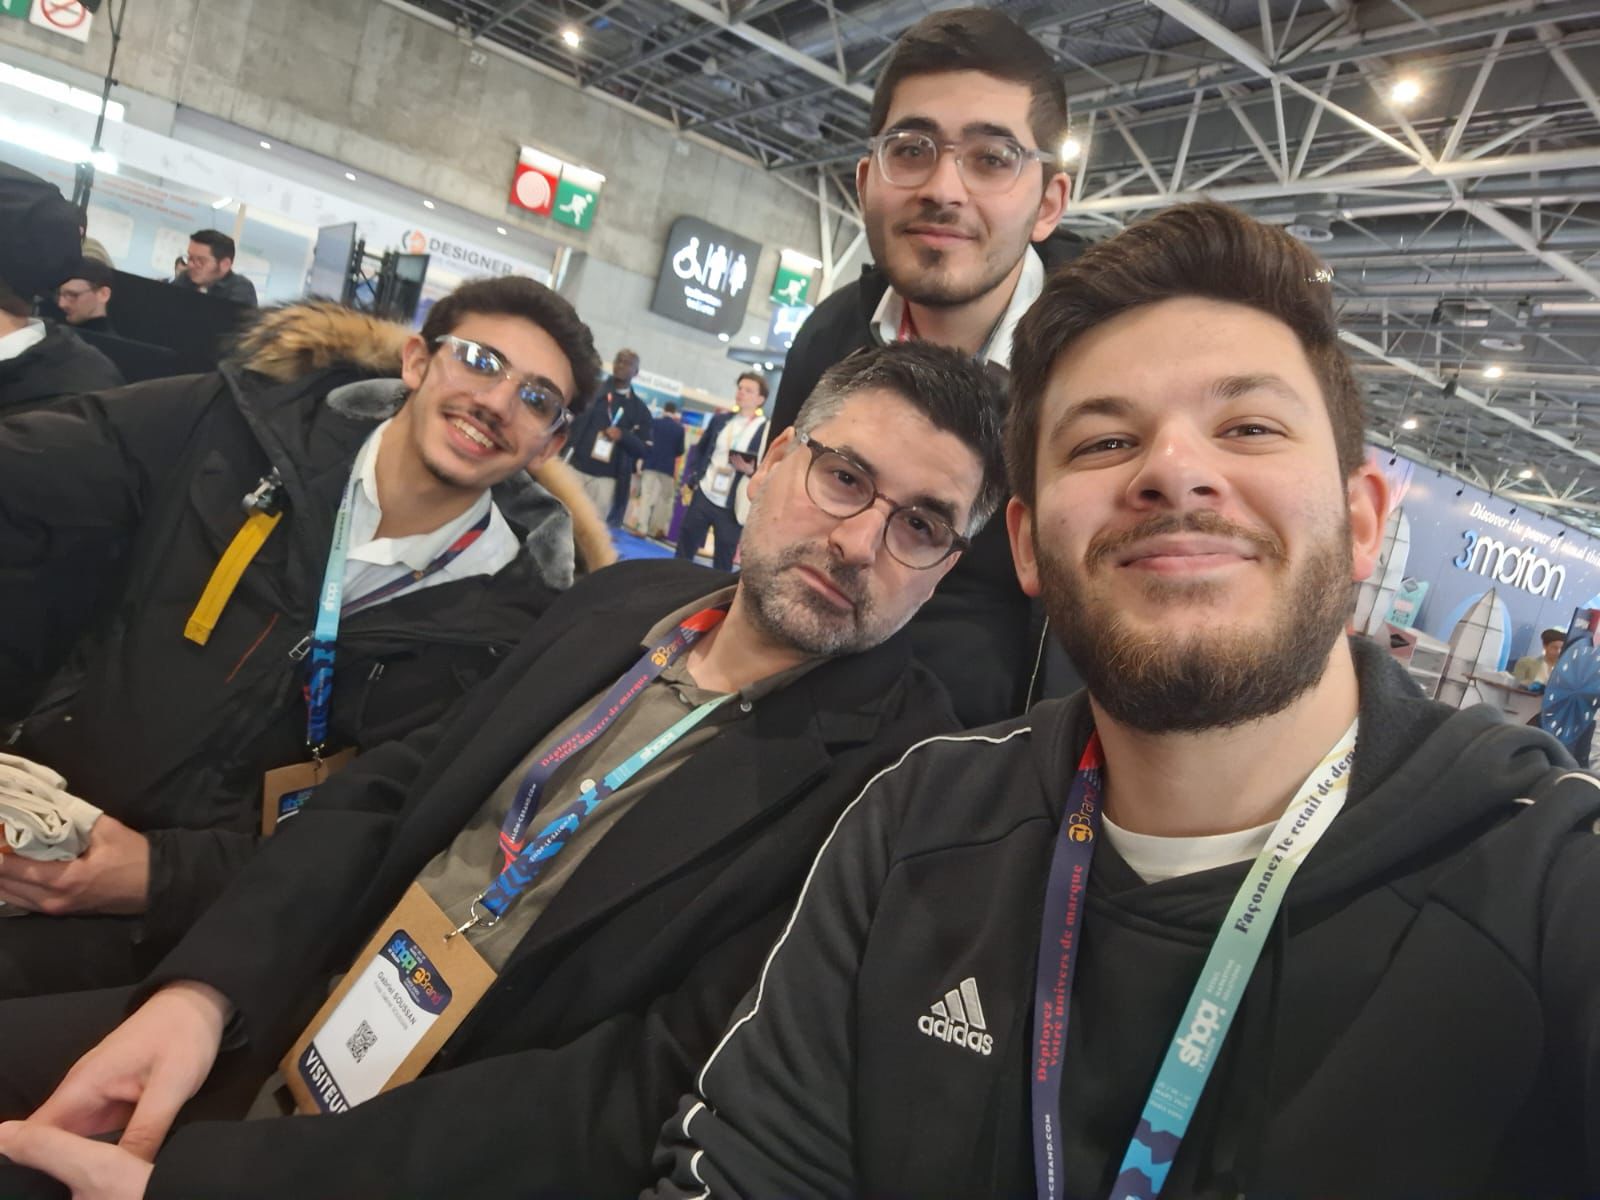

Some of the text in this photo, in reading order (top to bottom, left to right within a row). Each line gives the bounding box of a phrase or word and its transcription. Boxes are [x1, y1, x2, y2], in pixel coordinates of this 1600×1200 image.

[429, 237, 513, 273] DESIGNER
[1470, 501, 1509, 528] Discover
[1454, 529, 1566, 601] 3motion
[1233, 738, 1358, 935] Façonnez le retail de dem
[1065, 864, 1084, 926] marque
[1059, 929, 1073, 949] de
[1053, 953, 1070, 1016] univers
[917, 1015, 994, 1056] adidas
[1037, 1001, 1053, 1082] Déployez
